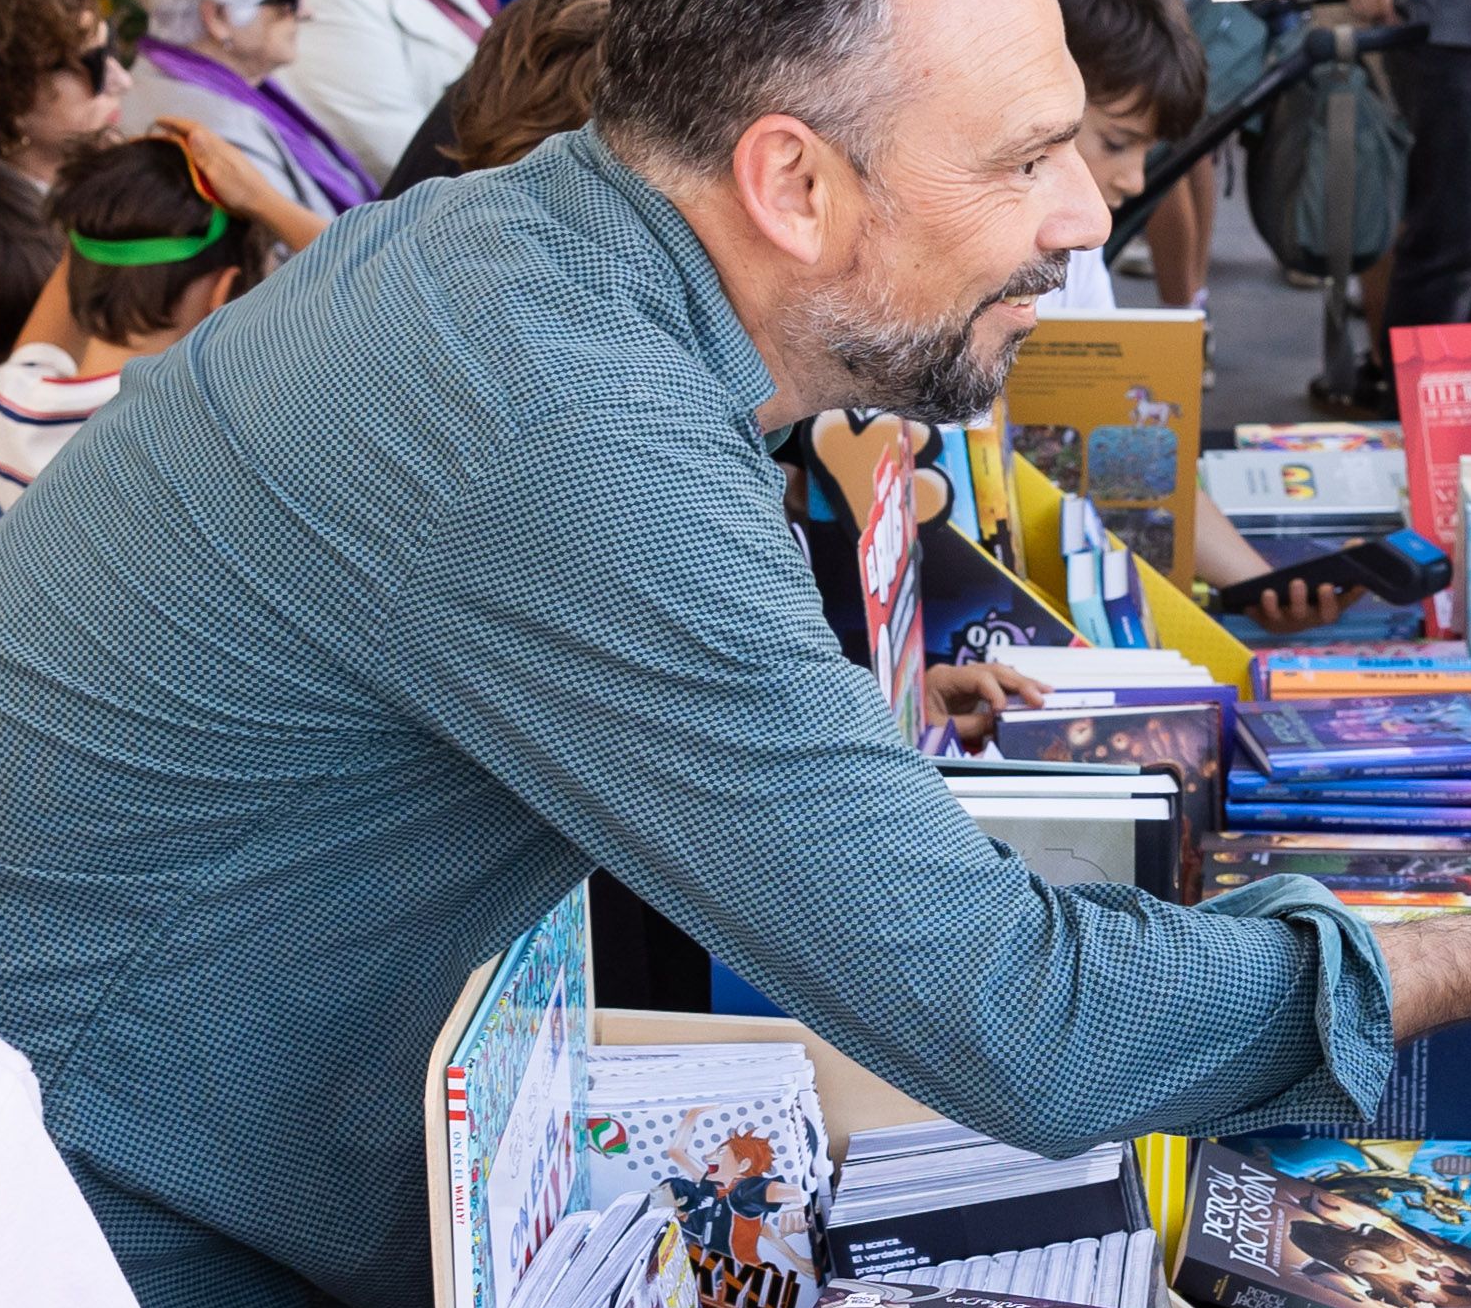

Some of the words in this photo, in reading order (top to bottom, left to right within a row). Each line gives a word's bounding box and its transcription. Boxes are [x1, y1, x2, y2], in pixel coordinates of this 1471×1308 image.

[453, 1131, 462, 1149] ON
[456, 1166, 464, 1180] EL
[455, 1185, 465, 1226] WALLY?
[1202, 1164, 1238, 1243] PERCY
[1230, 1162, 1278, 1277] JACKSON
[850, 1244, 863, 1253] Se
[853, 1255, 862, 1264] El
[864, 1246, 915, 1261] verdadero
[855, 1258, 915, 1276] protagonista
[917, 1255, 930, 1264] de
[1247, 1285, 1286, 1307] PERCY
